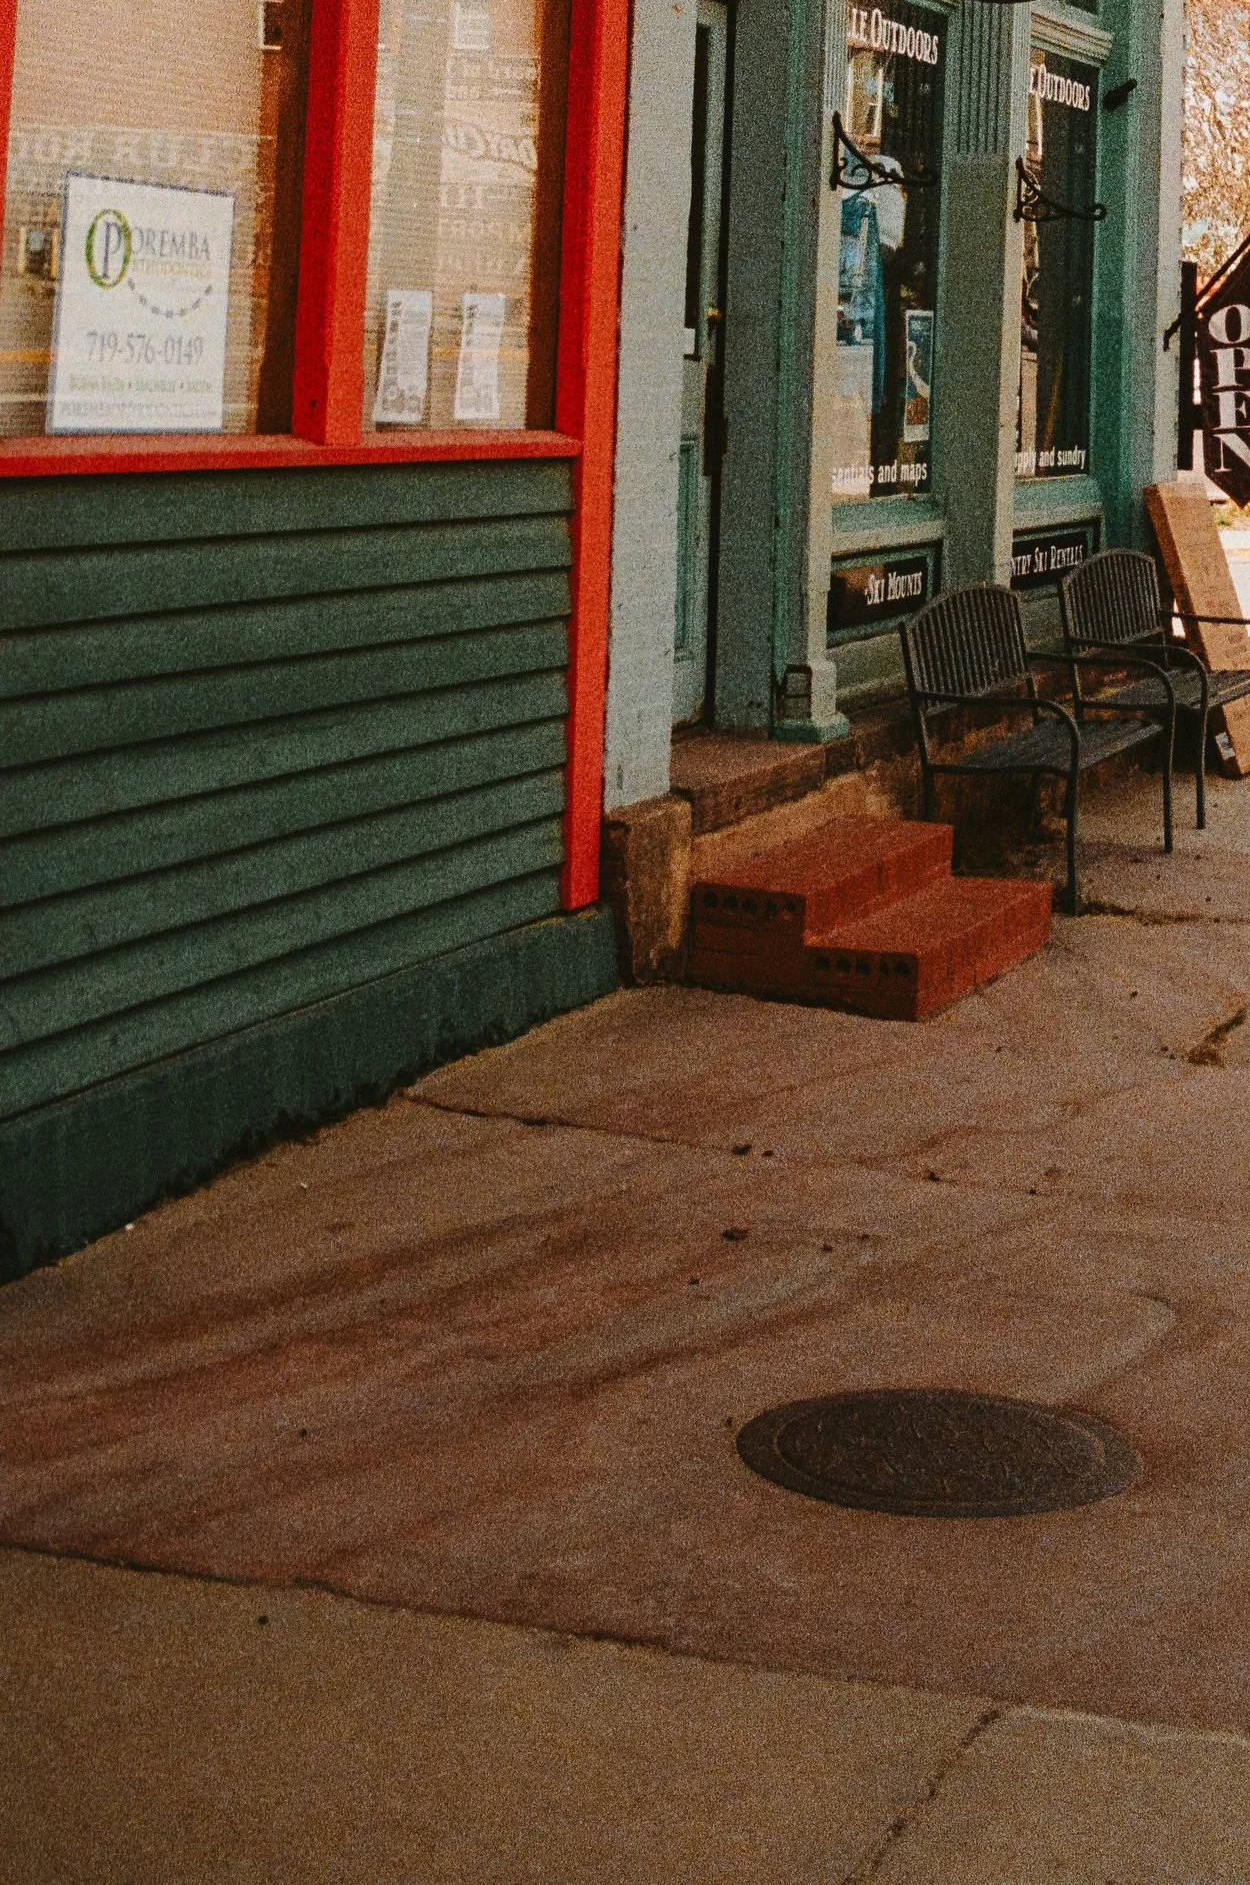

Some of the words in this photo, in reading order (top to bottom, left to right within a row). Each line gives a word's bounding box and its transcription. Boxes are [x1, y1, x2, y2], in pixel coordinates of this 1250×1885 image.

[87, 329, 204, 366] 719-576-0149
[1039, 446, 1055, 467] and
[1057, 445, 1086, 470] sundry
[878, 460, 897, 484] and
[900, 462, 928, 487] maps
